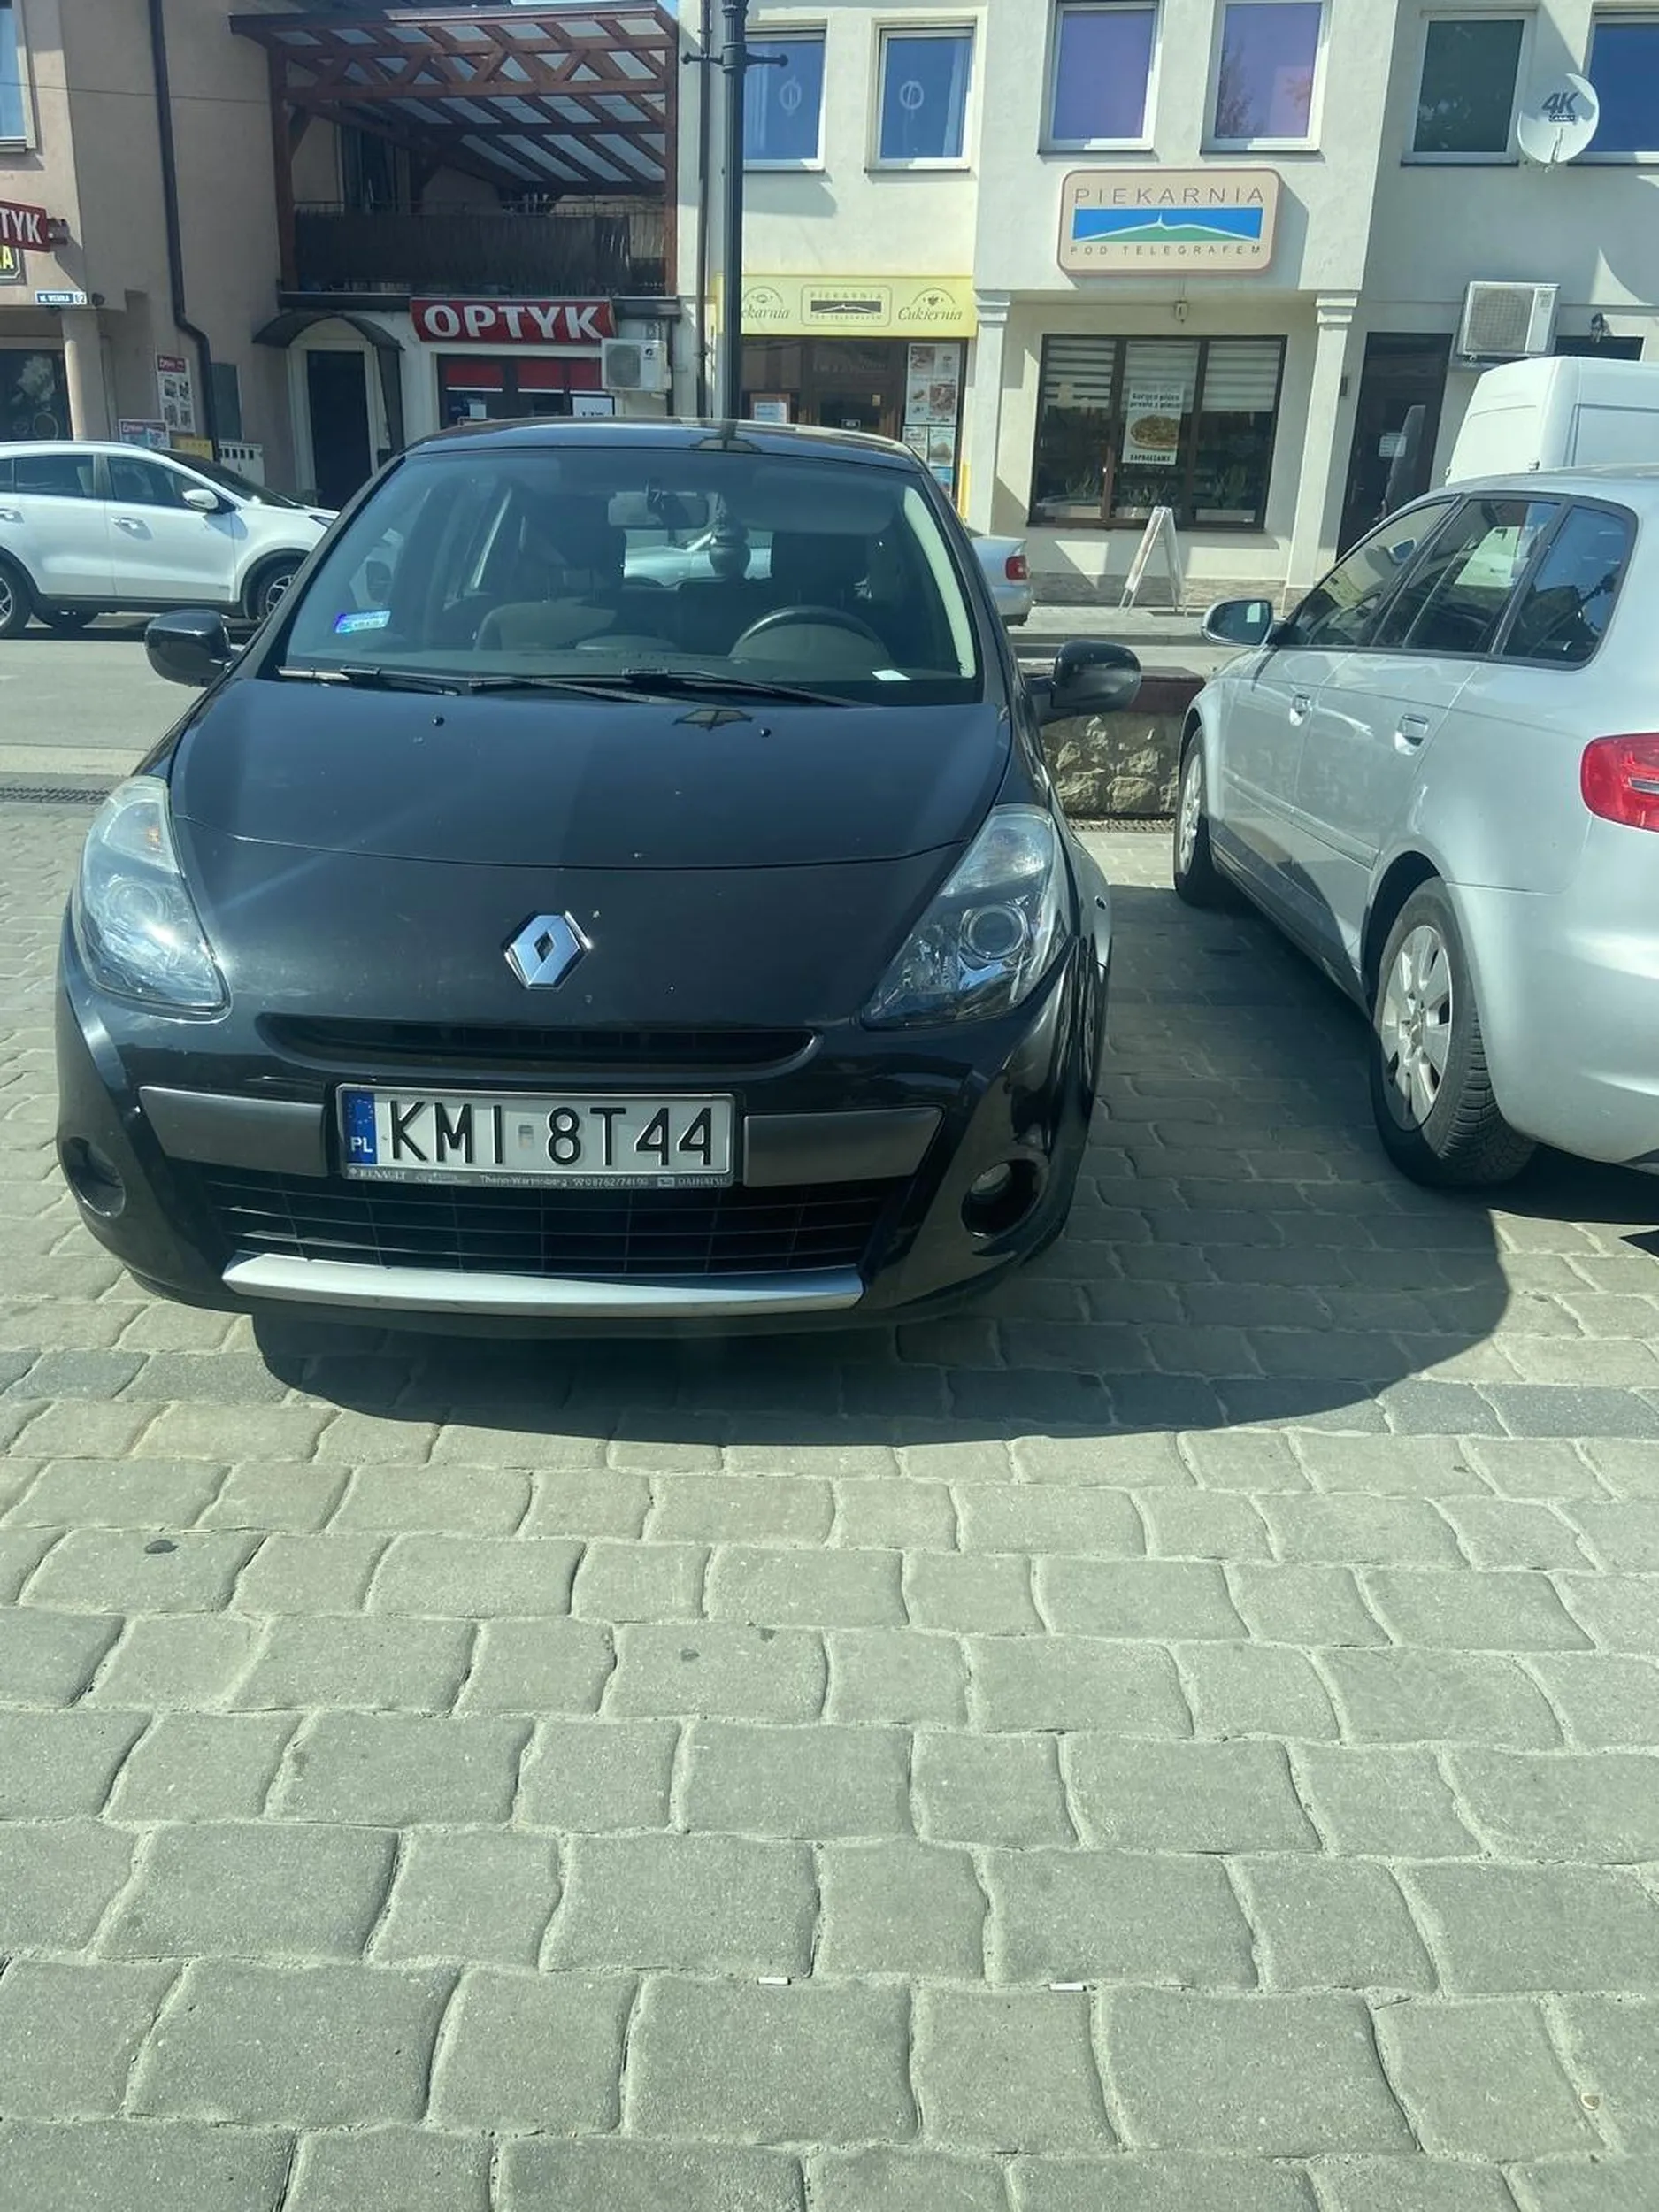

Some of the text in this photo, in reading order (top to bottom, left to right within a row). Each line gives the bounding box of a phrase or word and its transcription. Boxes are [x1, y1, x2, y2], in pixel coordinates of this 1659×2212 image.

[1541, 91, 1580, 114] 4K
[1073, 187, 1264, 205] PIEKARNIA
[1071, 244, 1262, 256] POD TELEGRAFEM
[424, 305, 603, 340] OPTYK
[898, 306, 962, 321] Cukiernia
[388, 1100, 713, 1167] KMI 8T44
[350, 1135, 373, 1154] PL
[359, 1168, 407, 1181] RENAULT
